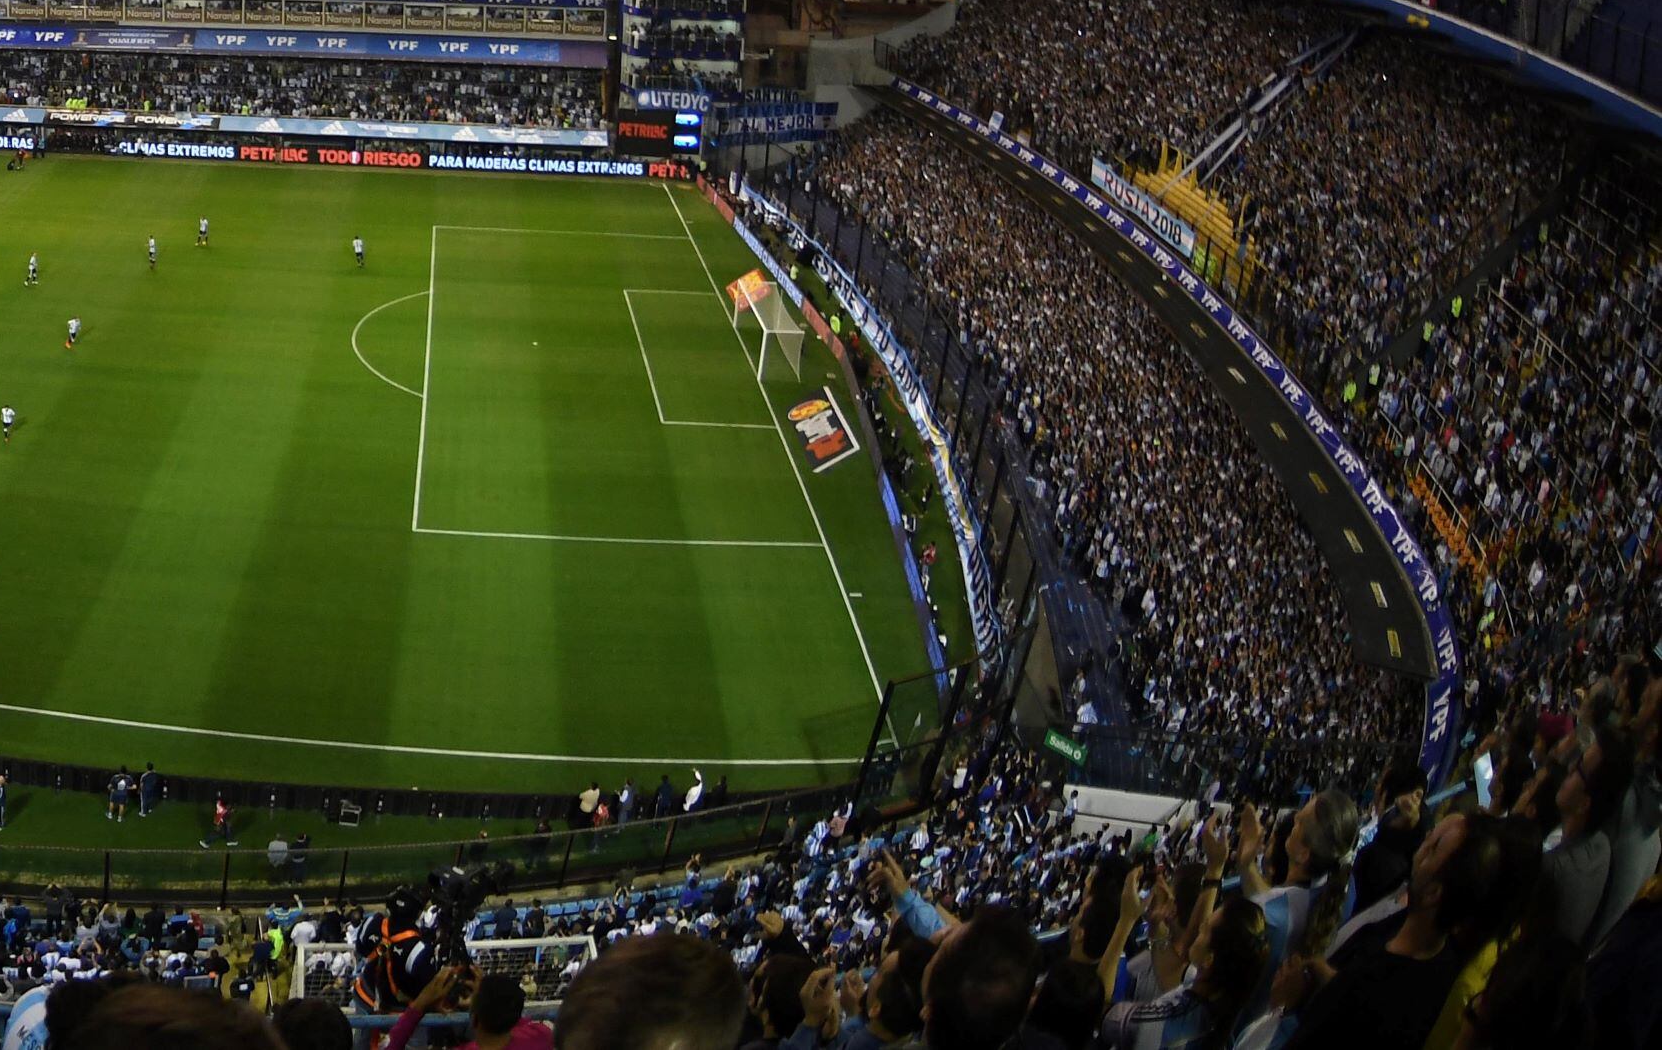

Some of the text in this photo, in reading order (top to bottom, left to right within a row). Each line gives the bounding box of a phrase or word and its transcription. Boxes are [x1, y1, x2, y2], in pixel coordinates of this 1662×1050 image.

[11, 6, 44, 16] Naranja
[167, 10, 201, 20] Naranja
[367, 16, 402, 26] Naranja
[567, 22, 602, 34] Naranja
[215, 34, 520, 55] YPF YPF YPF YPF
[650, 90, 710, 112] UTEDYC
[50, 112, 127, 124] POWERADE
[167, 143, 235, 158] EXTREMOS
[363, 150, 422, 167] RIESGO
[428, 154, 464, 168] PARA
[466, 156, 527, 171] MADERAS
[528, 158, 574, 173] CLIMAS
[577, 160, 643, 176] EXTREMOS
[1103, 168, 1182, 246] RUSIA 2018
[874, 326, 887, 350] TU
[889, 349, 920, 403] LADO
[956, 110, 1451, 742] YPF YPF YPF YPF YPF YPF YPF
[1049, 736, 1074, 754] Salida
